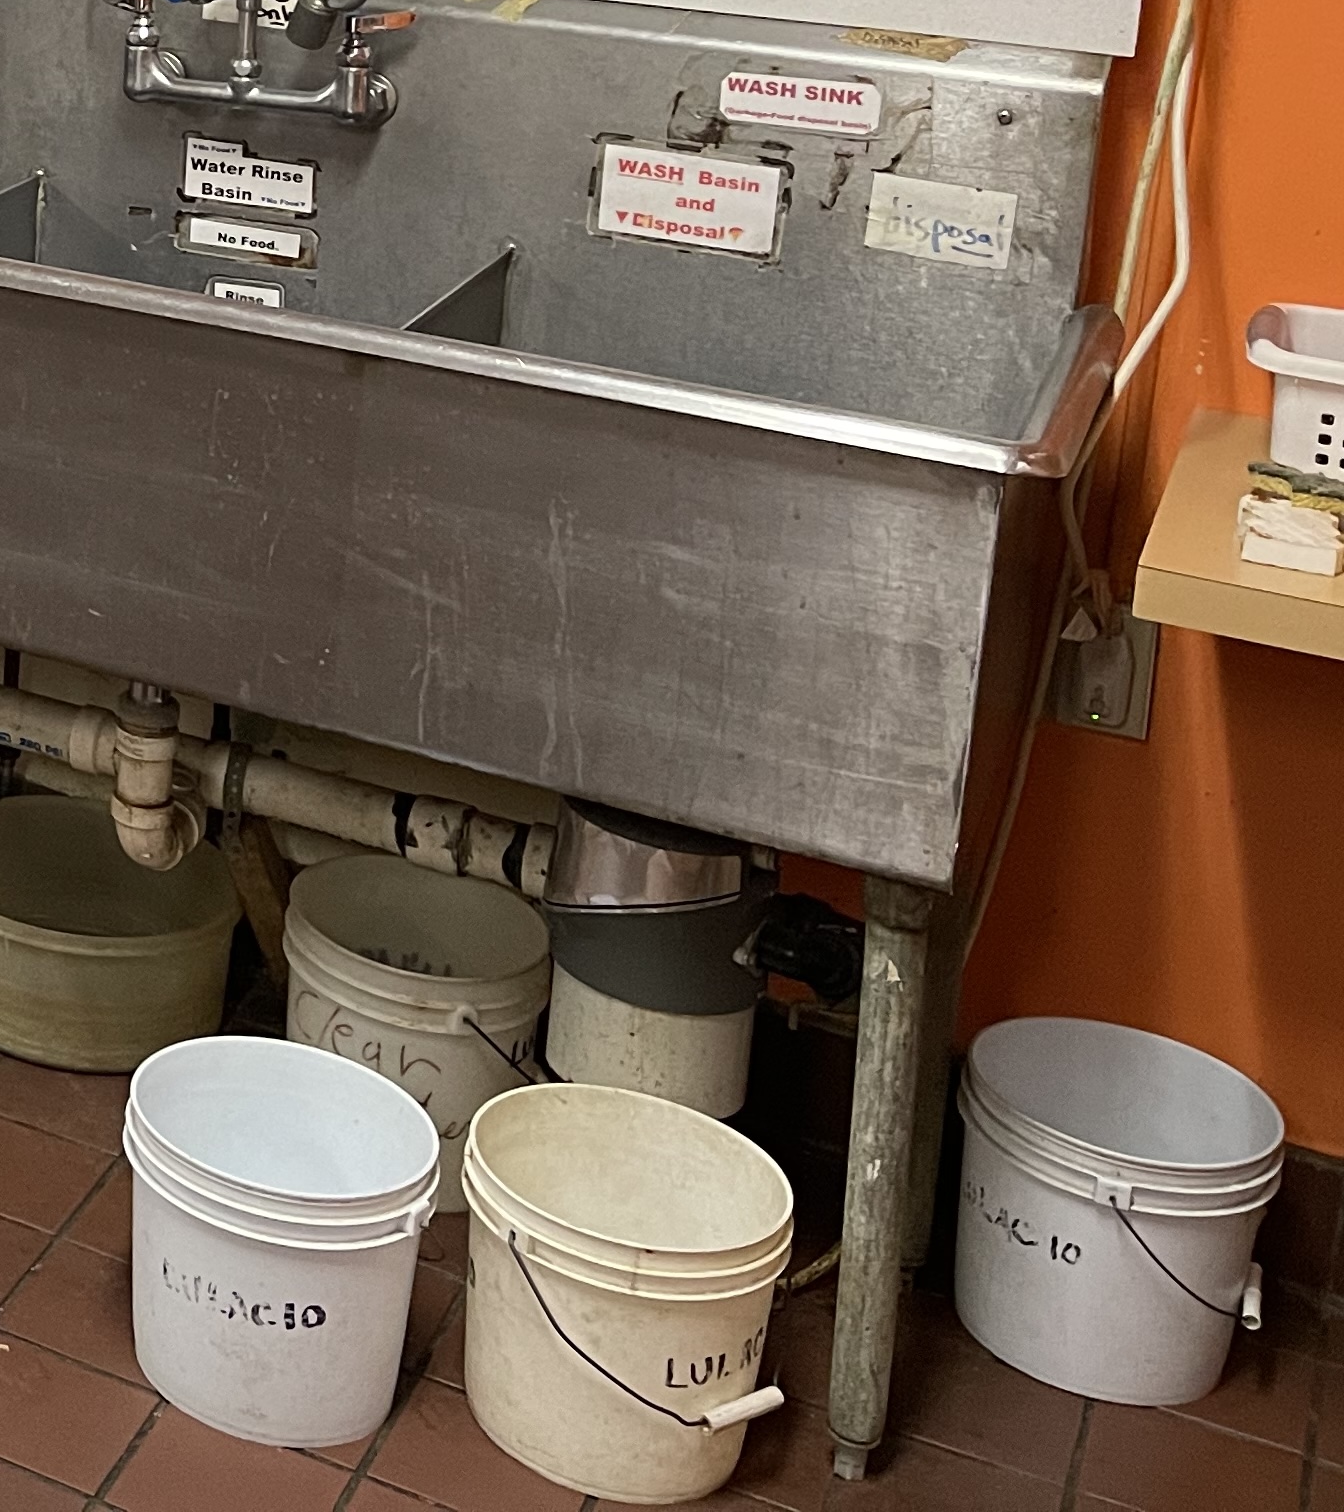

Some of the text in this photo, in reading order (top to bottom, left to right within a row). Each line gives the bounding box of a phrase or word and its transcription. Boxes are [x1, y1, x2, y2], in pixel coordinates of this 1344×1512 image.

[728, 76, 864, 106] WASH SINK
[190, 156, 304, 184] Water Rinse
[617, 157, 761, 193] WASH Basin
[201, 182, 252, 201] Basin
[675, 195, 716, 213] and
[632, 212, 726, 239] Disposal
[217, 231, 280, 252] No Food.
[225, 290, 265, 305] Rinse
